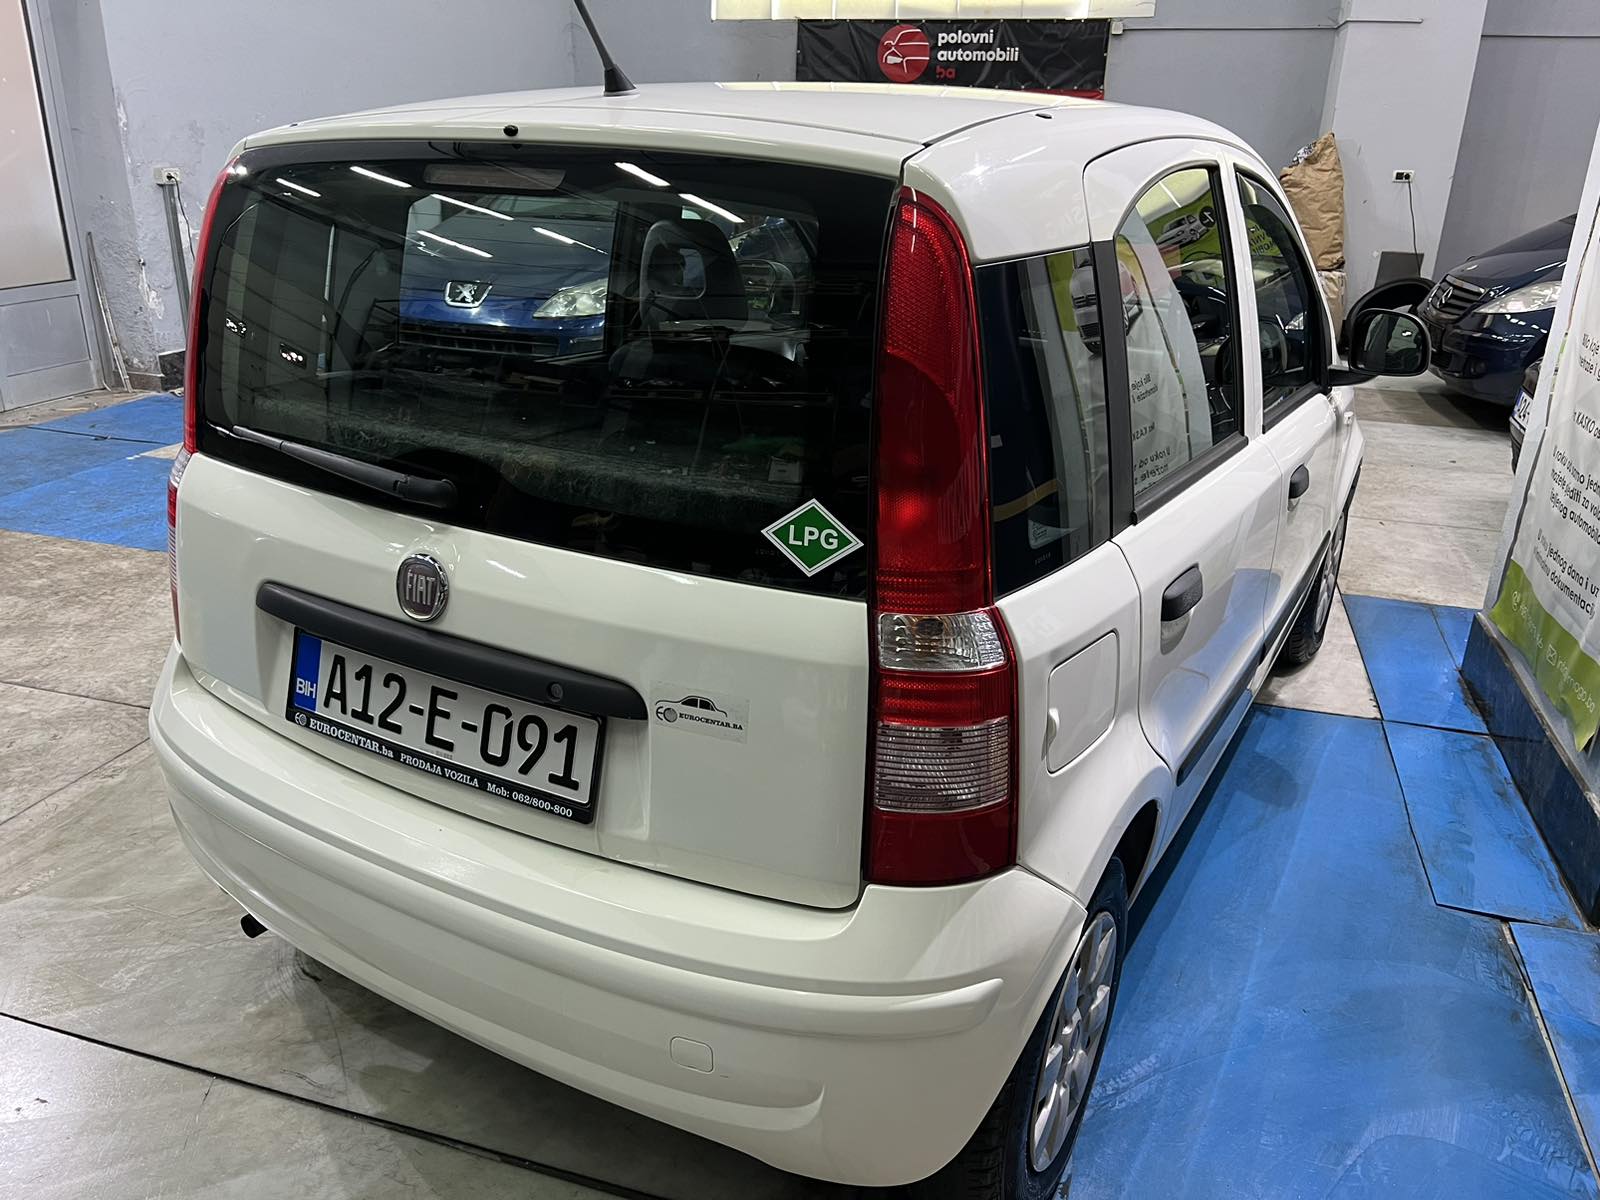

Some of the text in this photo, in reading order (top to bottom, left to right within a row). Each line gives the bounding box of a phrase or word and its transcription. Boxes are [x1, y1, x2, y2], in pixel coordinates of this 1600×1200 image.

[938, 29, 994, 47] polovni
[937, 46, 1019, 62] automobili
[788, 524, 839, 550] LPG
[405, 568, 437, 605] FIAT
[1567, 563, 1584, 587] dana
[1585, 577, 1590, 591] i
[1590, 583, 1600, 598] uz
[295, 677, 317, 699] BIH
[323, 654, 580, 791] A12-E-091
[679, 712, 743, 730] EUROCENTAR.BA
[309, 718, 394, 759] EUROCENTAR.ba
[400, 753, 443, 776] PRODAJA
[444, 767, 479, 788] VOZILA
[487, 782, 510, 798] Mob:
[512, 791, 573, 818] 062/800-800
